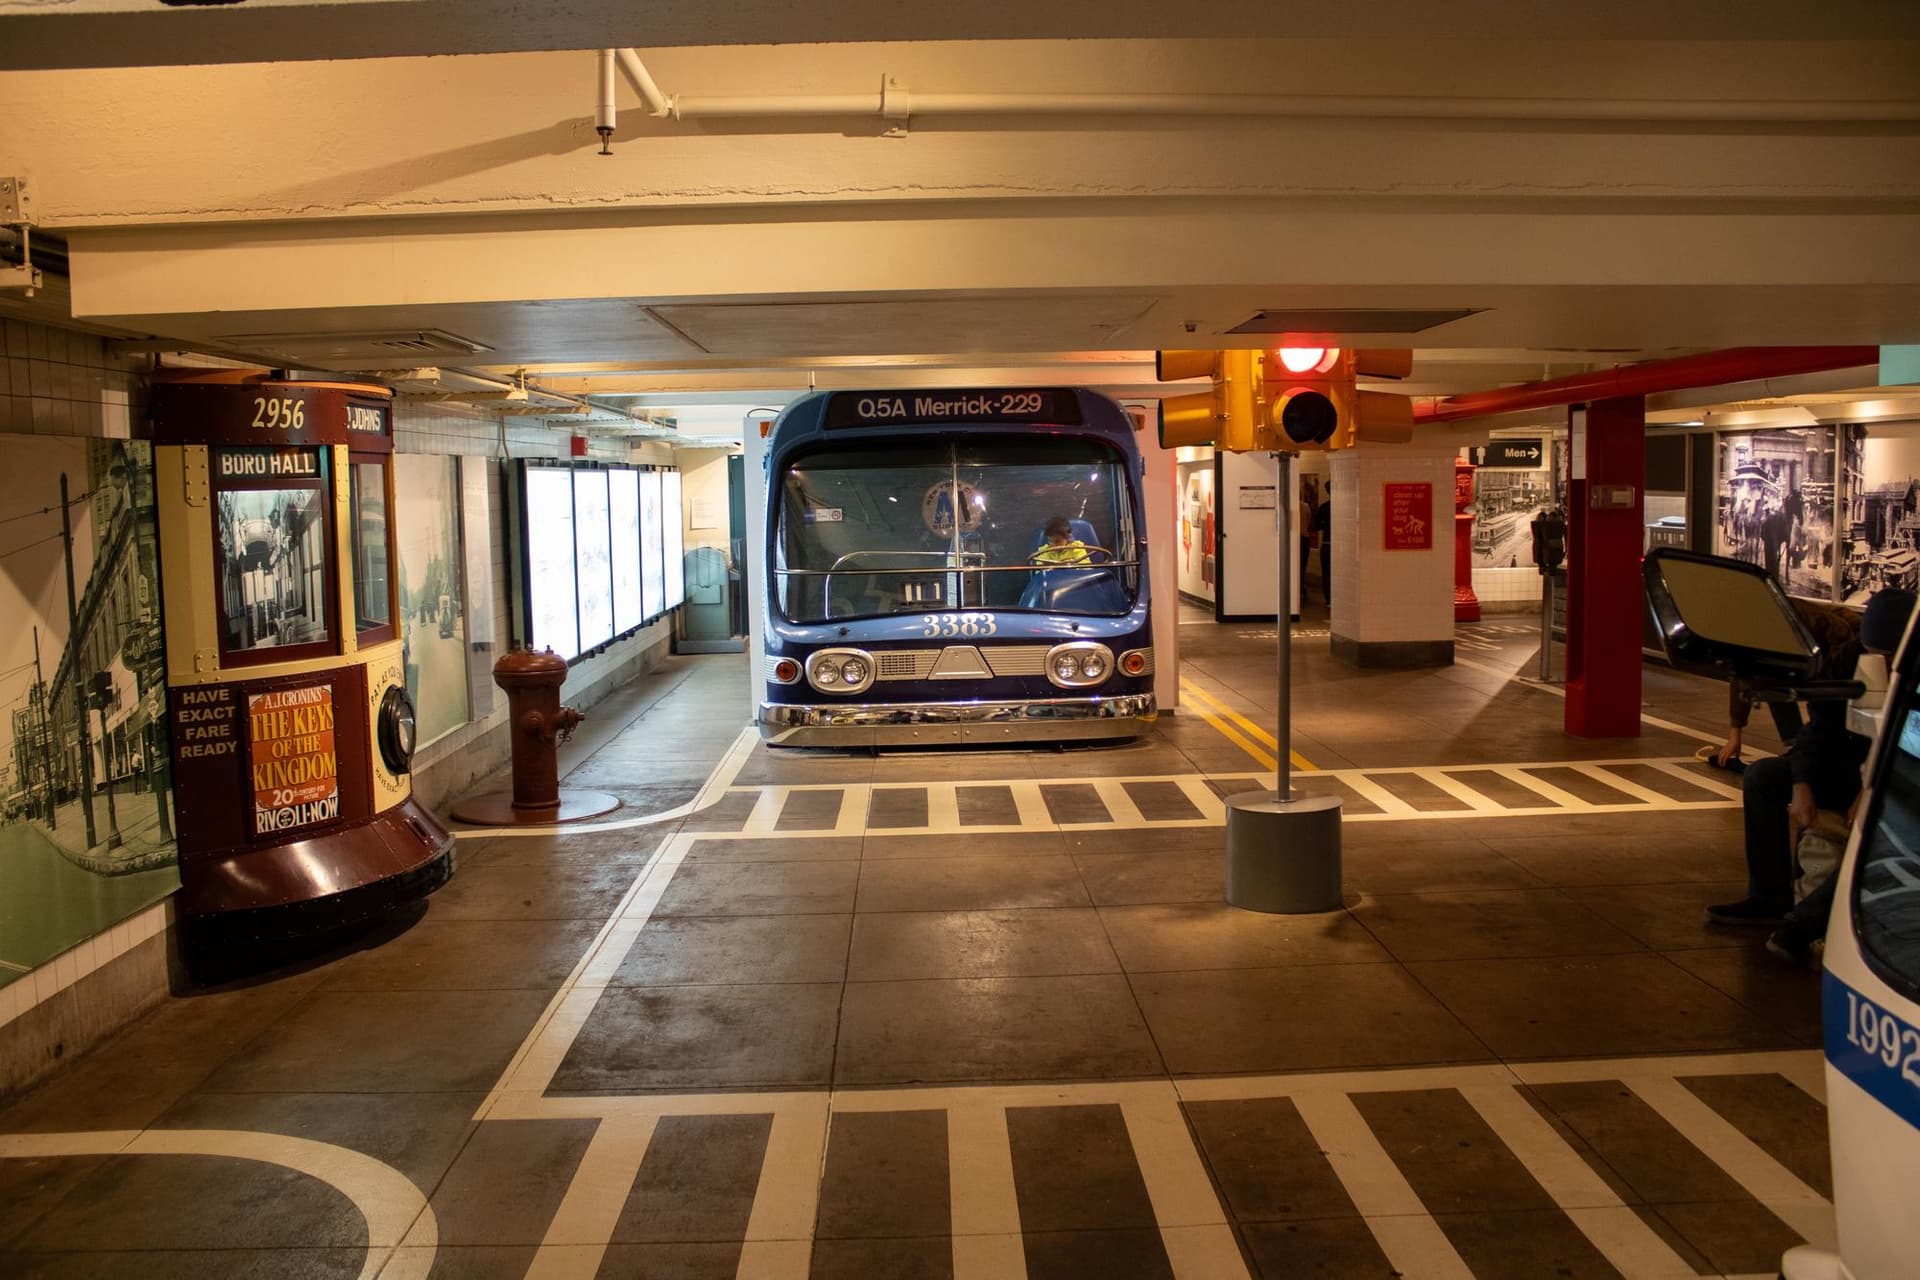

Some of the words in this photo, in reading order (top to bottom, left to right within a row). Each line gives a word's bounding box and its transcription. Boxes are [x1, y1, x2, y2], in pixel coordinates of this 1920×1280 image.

[252, 398, 305, 429] 2956
[858, 398, 907, 418] Q5A
[915, 393, 1042, 416] Merrick-229
[352, 407, 381, 431] JOHNS
[222, 453, 266, 475] BORO
[270, 452, 315, 474] HALL
[1505, 448, 1526, 457] Men
[923, 613, 997, 637] 3383
[183, 689, 230, 705] HAVE
[179, 706, 236, 722] EXACT
[250, 710, 290, 742] THE
[293, 704, 334, 735] KEYS
[186, 724, 231, 740] FARE
[180, 741, 238, 758] READY
[271, 740, 292, 758] OF
[293, 735, 320, 754] THE
[253, 752, 336, 791] KINGDOM
[1846, 992, 1920, 1089] 1992
